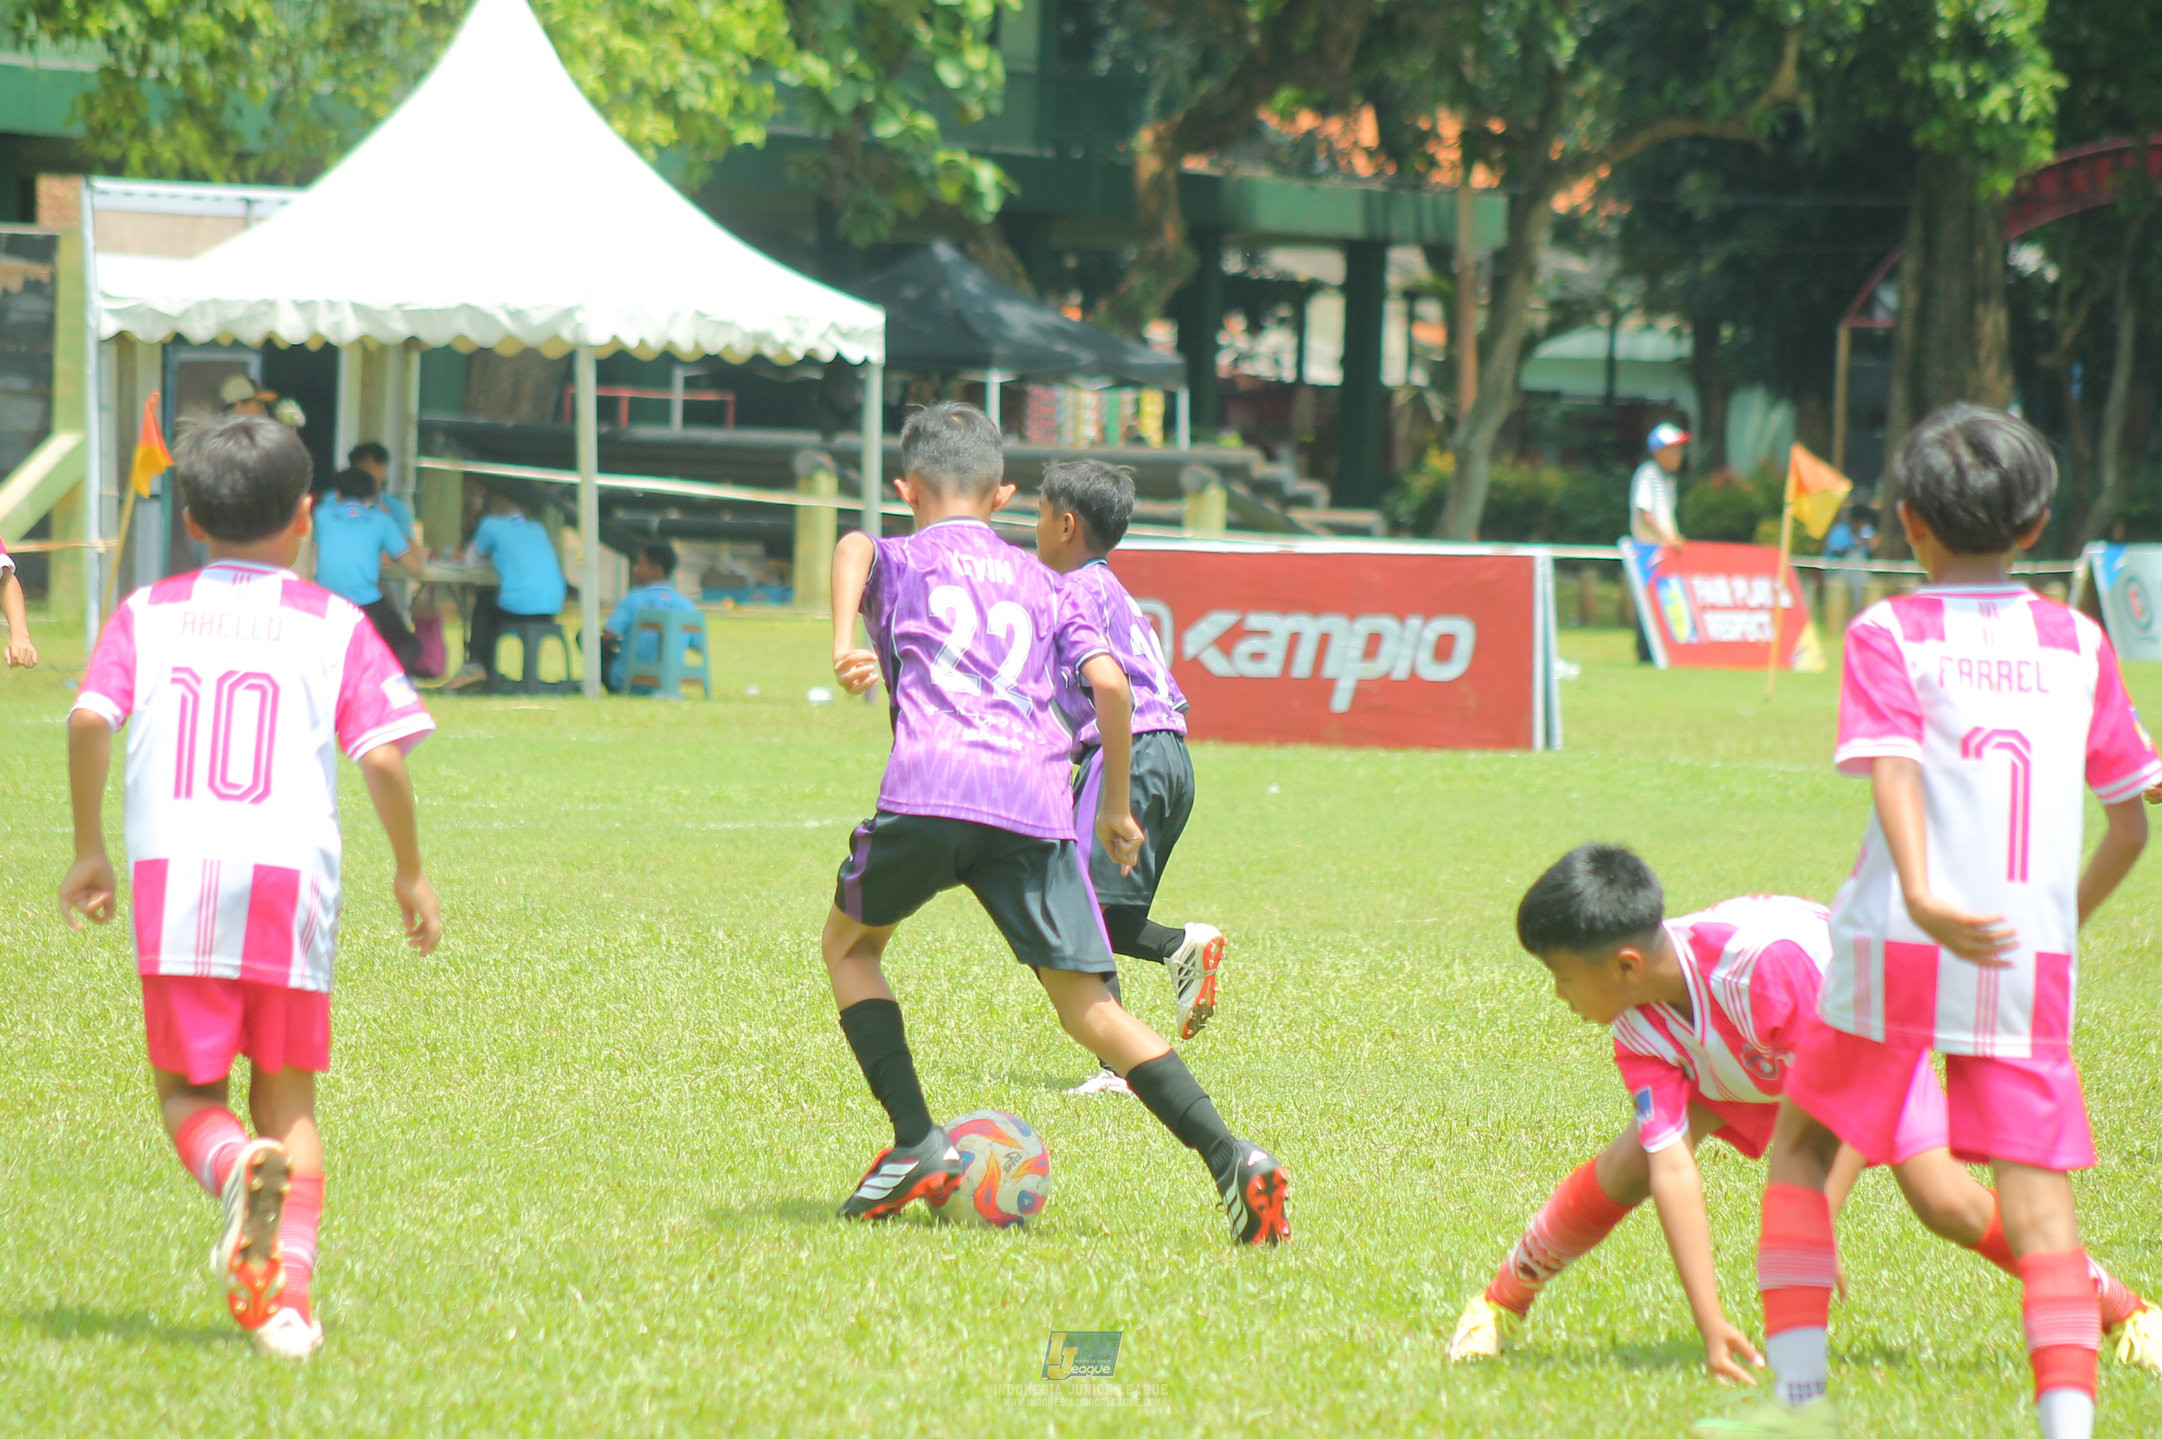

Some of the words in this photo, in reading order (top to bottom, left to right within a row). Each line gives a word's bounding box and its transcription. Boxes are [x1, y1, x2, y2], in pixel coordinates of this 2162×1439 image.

[928, 585, 1033, 718] 22
[1938, 655, 2050, 694] FARREL
[169, 666, 281, 805] 10
[1960, 726, 2032, 884] 7
